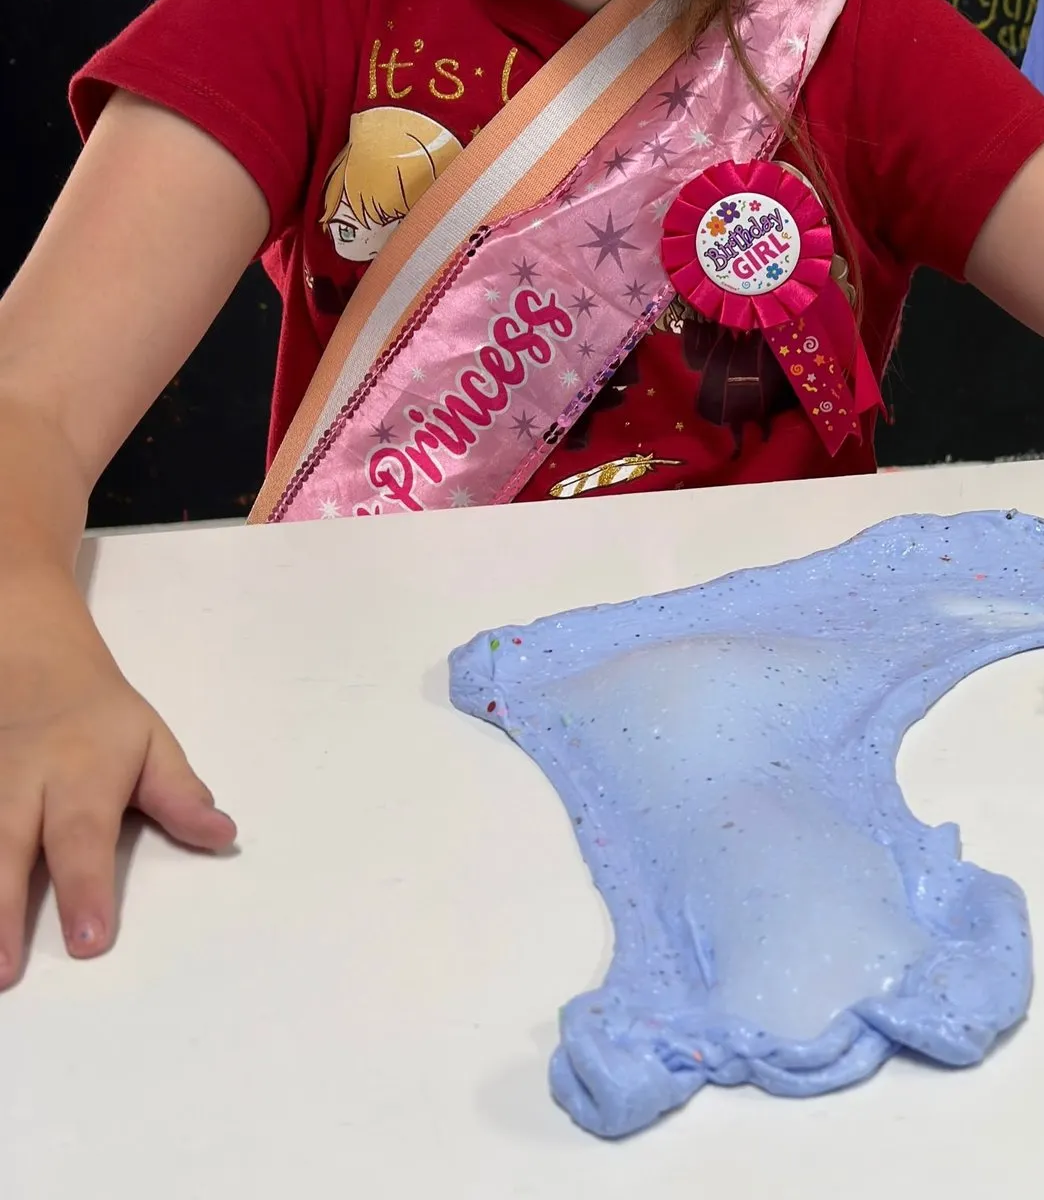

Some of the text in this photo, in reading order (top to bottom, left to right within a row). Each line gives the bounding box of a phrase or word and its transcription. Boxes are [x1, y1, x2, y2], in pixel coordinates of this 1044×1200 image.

[368, 38, 466, 102] It's
[703, 207, 784, 272] Birthday
[731, 232, 791, 280] GIRL
[367, 288, 577, 514] Princess
